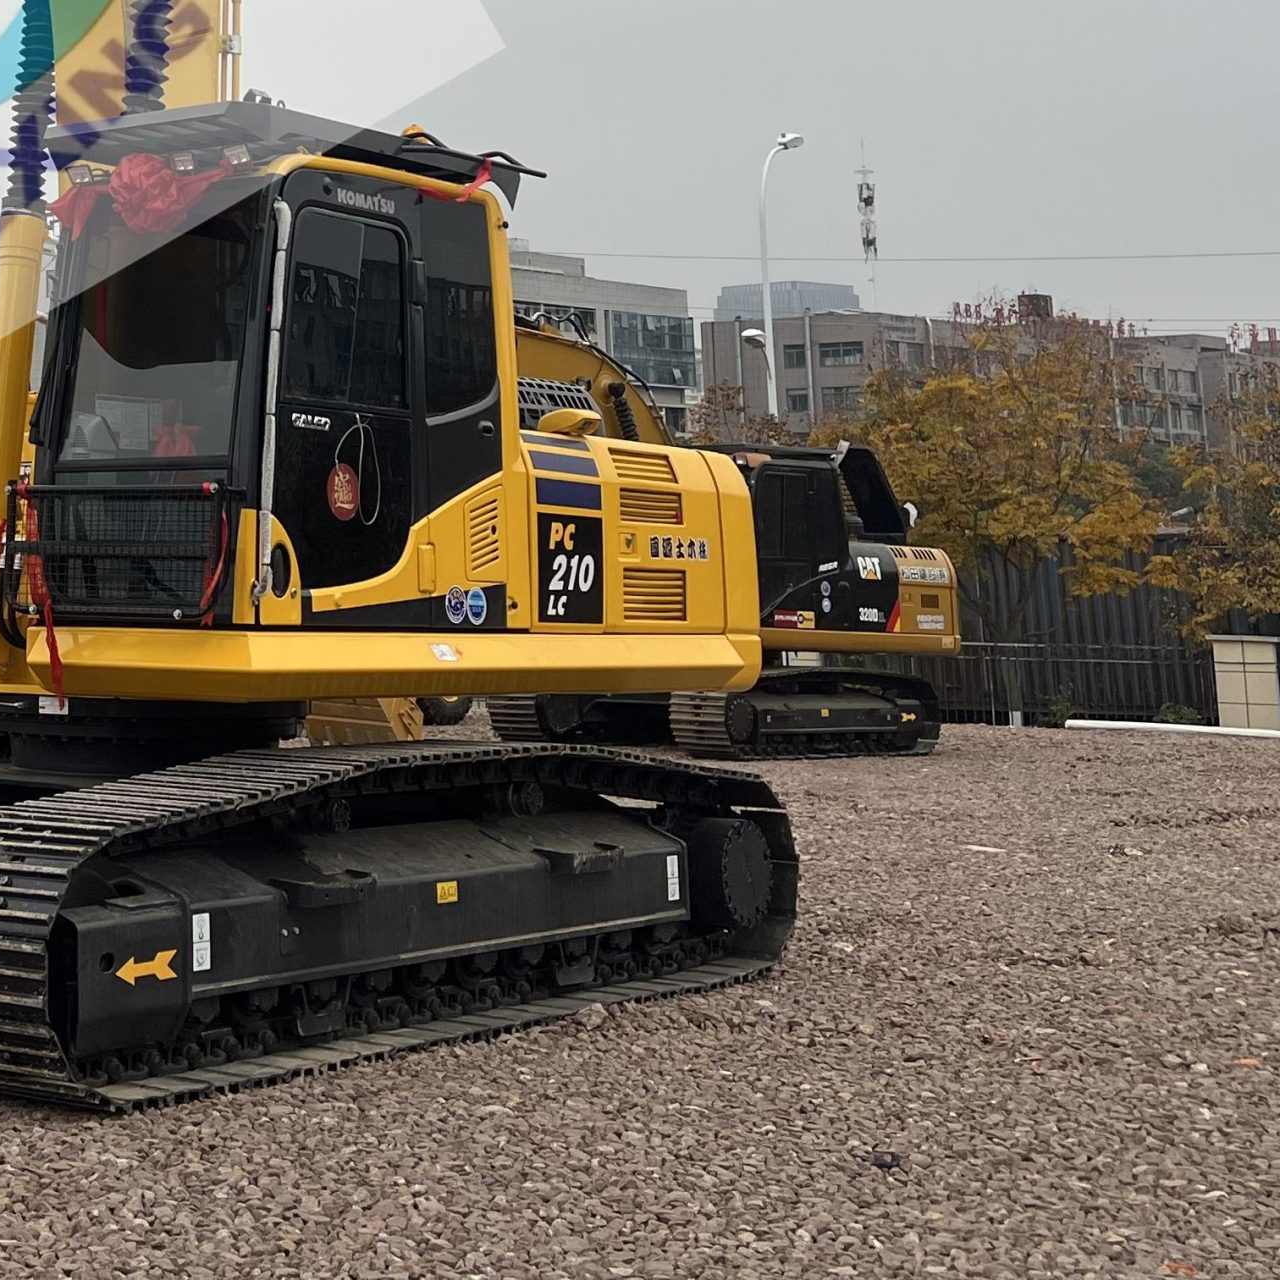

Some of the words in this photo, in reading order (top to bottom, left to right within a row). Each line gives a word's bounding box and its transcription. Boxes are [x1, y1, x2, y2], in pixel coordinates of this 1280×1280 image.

[337, 187, 396, 215] KOMATSU
[549, 521, 576, 551] PC
[548, 554, 596, 593] 210
[857, 556, 883, 581] CAT
[547, 594, 568, 616] LC
